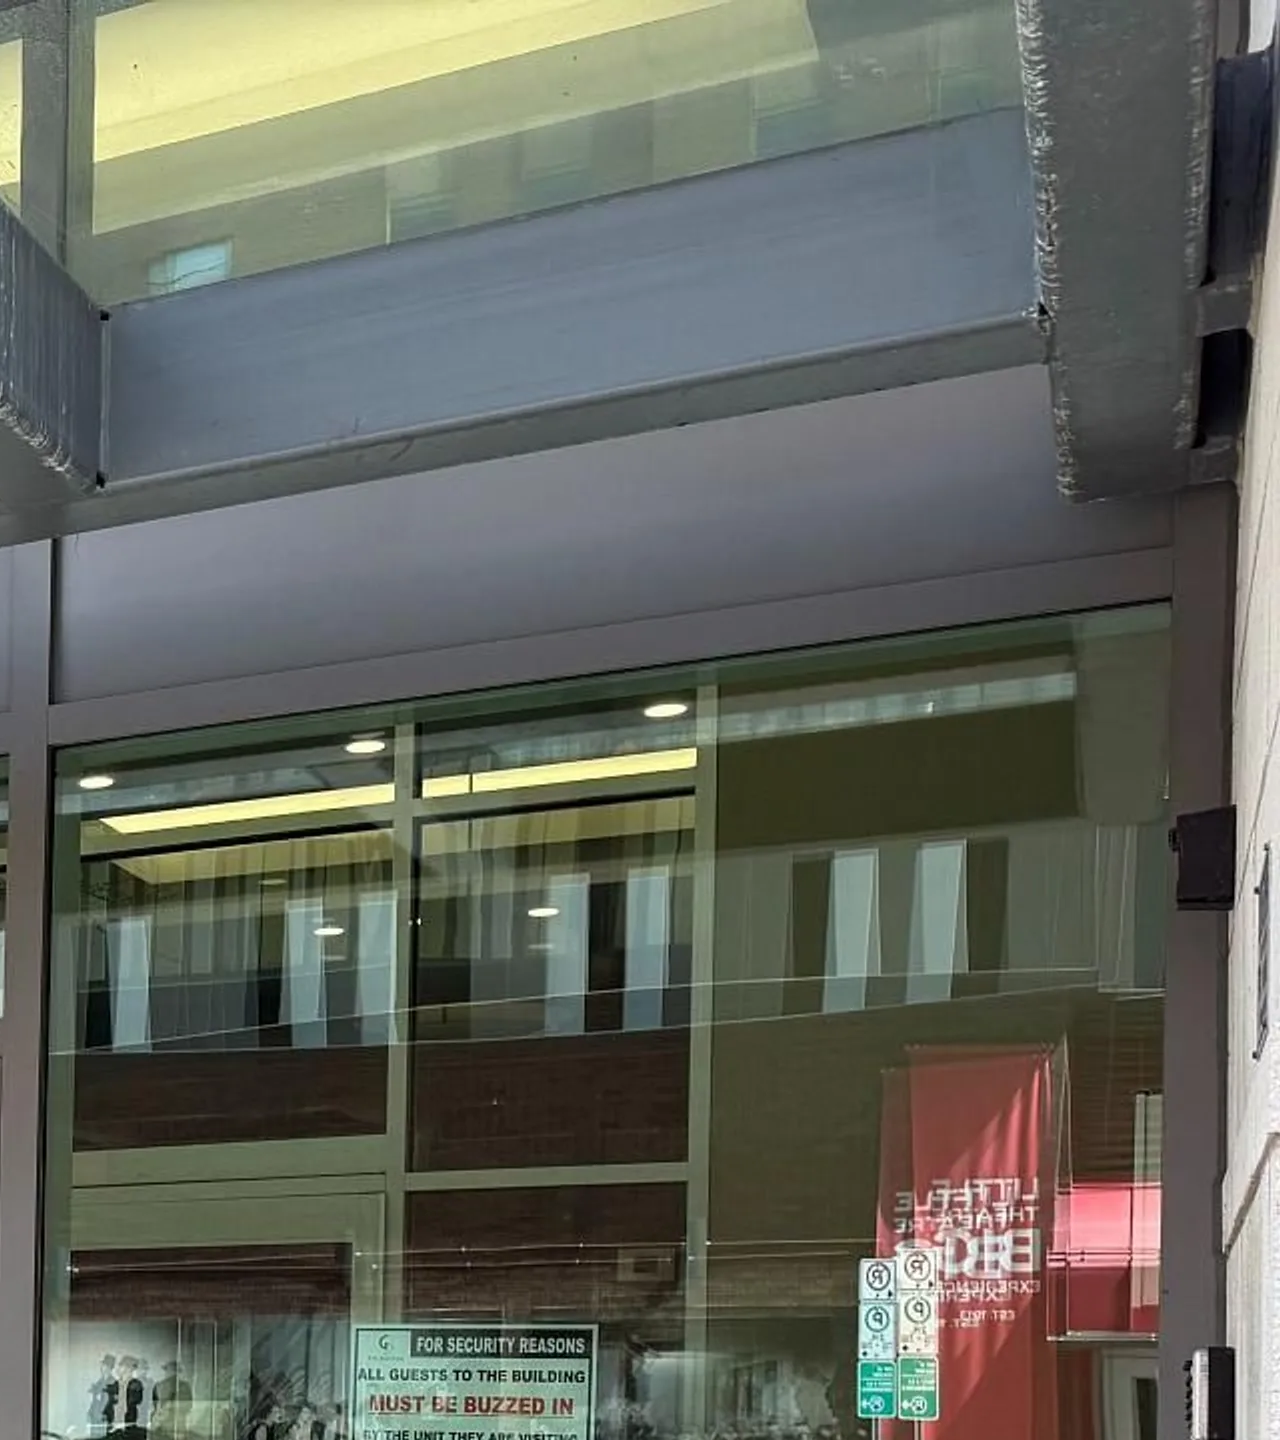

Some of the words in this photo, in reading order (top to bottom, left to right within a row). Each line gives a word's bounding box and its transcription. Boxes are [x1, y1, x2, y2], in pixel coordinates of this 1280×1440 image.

[415, 1337, 444, 1352] FOR
[447, 1337, 516, 1353] SECURITY
[519, 1337, 586, 1354] REASONS
[357, 1368, 385, 1381] ALL
[389, 1368, 448, 1382] GUESTS
[452, 1369, 473, 1382] TO
[477, 1369, 507, 1383] THE
[511, 1369, 586, 1384] BUILDING
[369, 1394, 425, 1412] MUST
[431, 1395, 458, 1413] BE
[463, 1396, 545, 1415] BUZZED
[552, 1397, 574, 1415] IN
